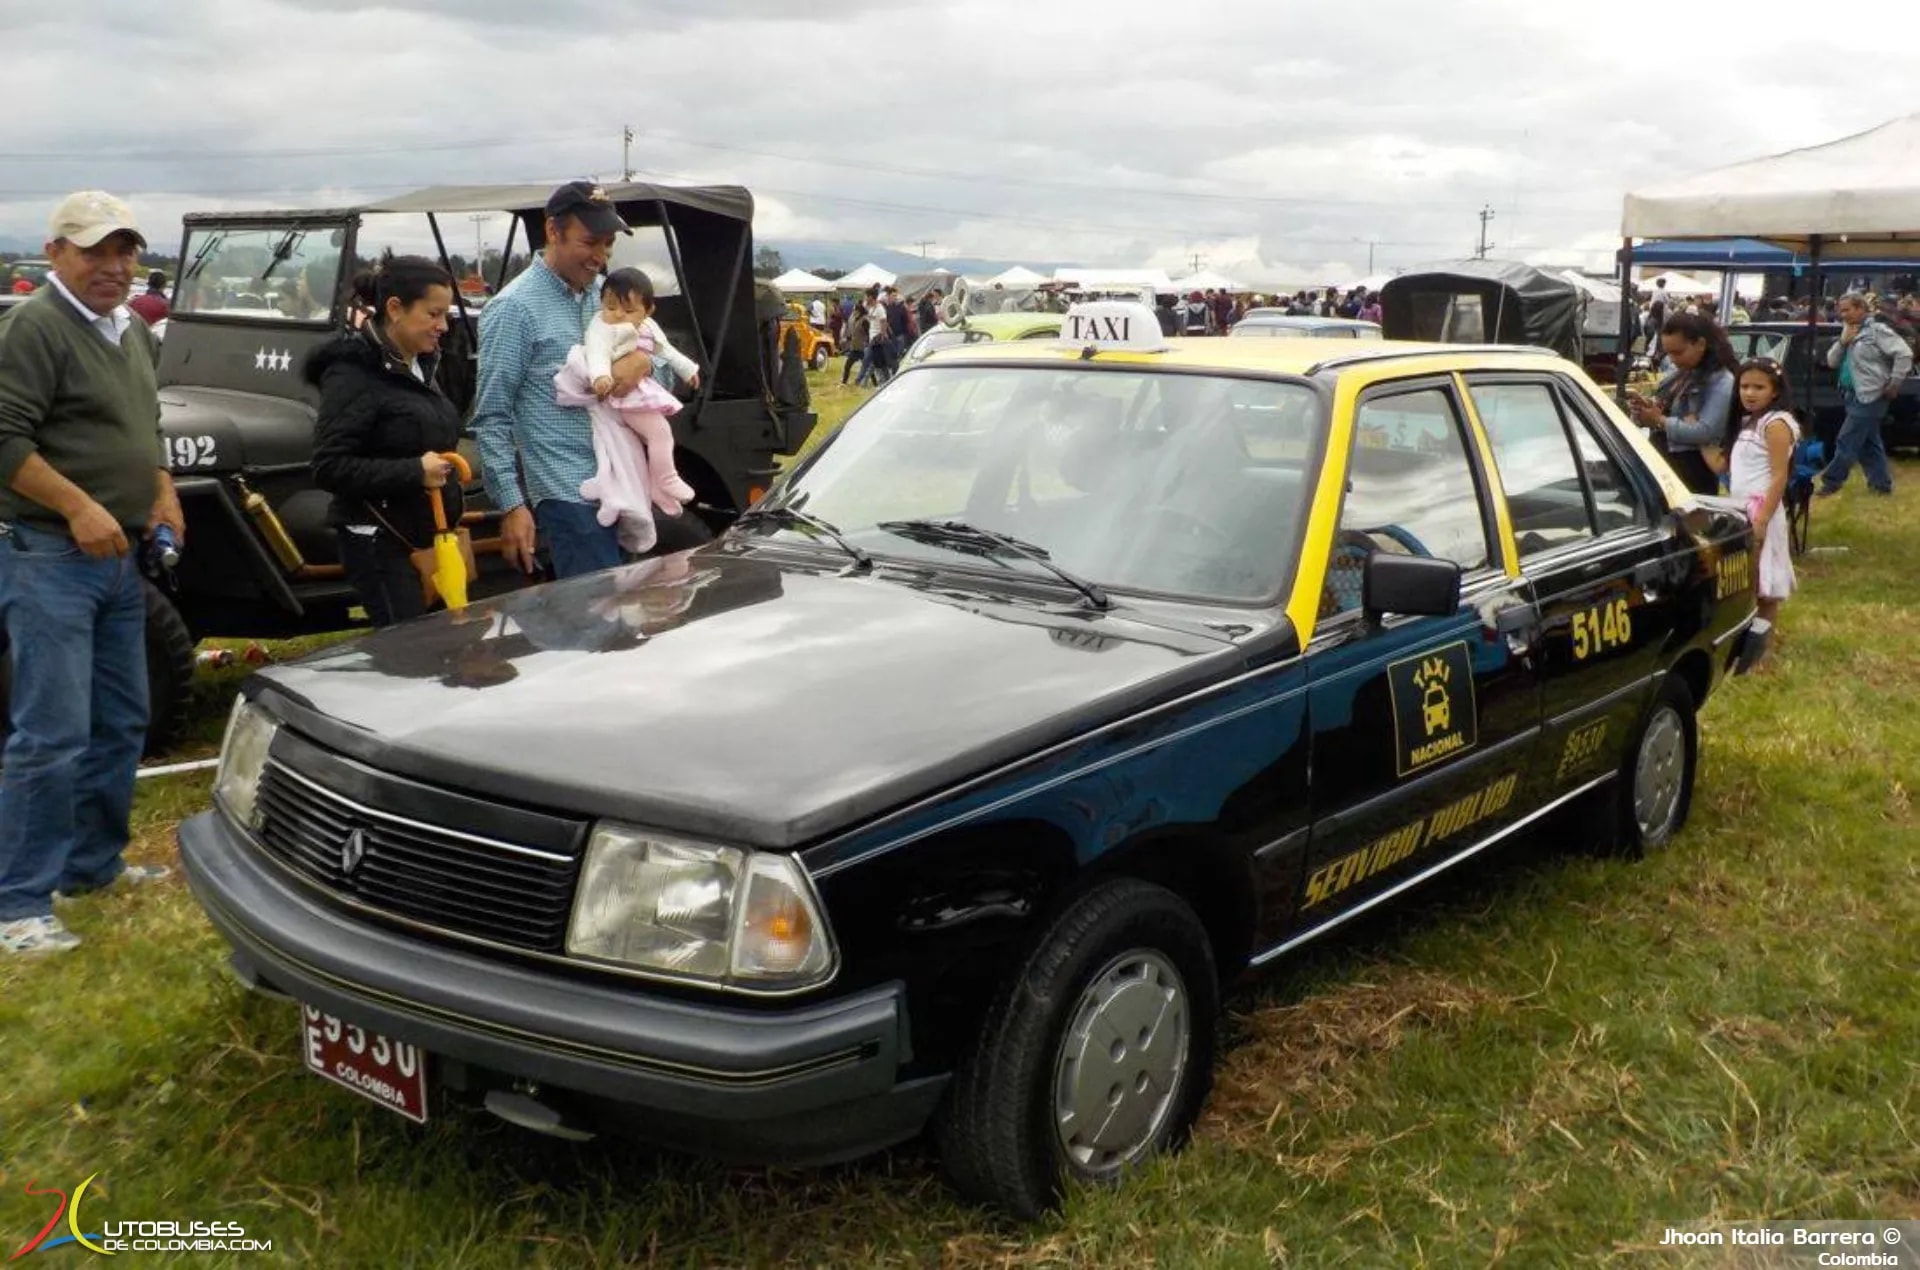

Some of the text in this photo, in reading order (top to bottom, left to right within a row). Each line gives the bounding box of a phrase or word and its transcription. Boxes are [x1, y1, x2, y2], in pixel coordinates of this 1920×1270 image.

[1069, 315, 1129, 341] TAXI
[1572, 599, 1632, 660] 5146
[1413, 657, 1450, 689] TAXI
[1411, 731, 1465, 766] NACIONAL
[335, 1061, 406, 1108] COLOMBIA
